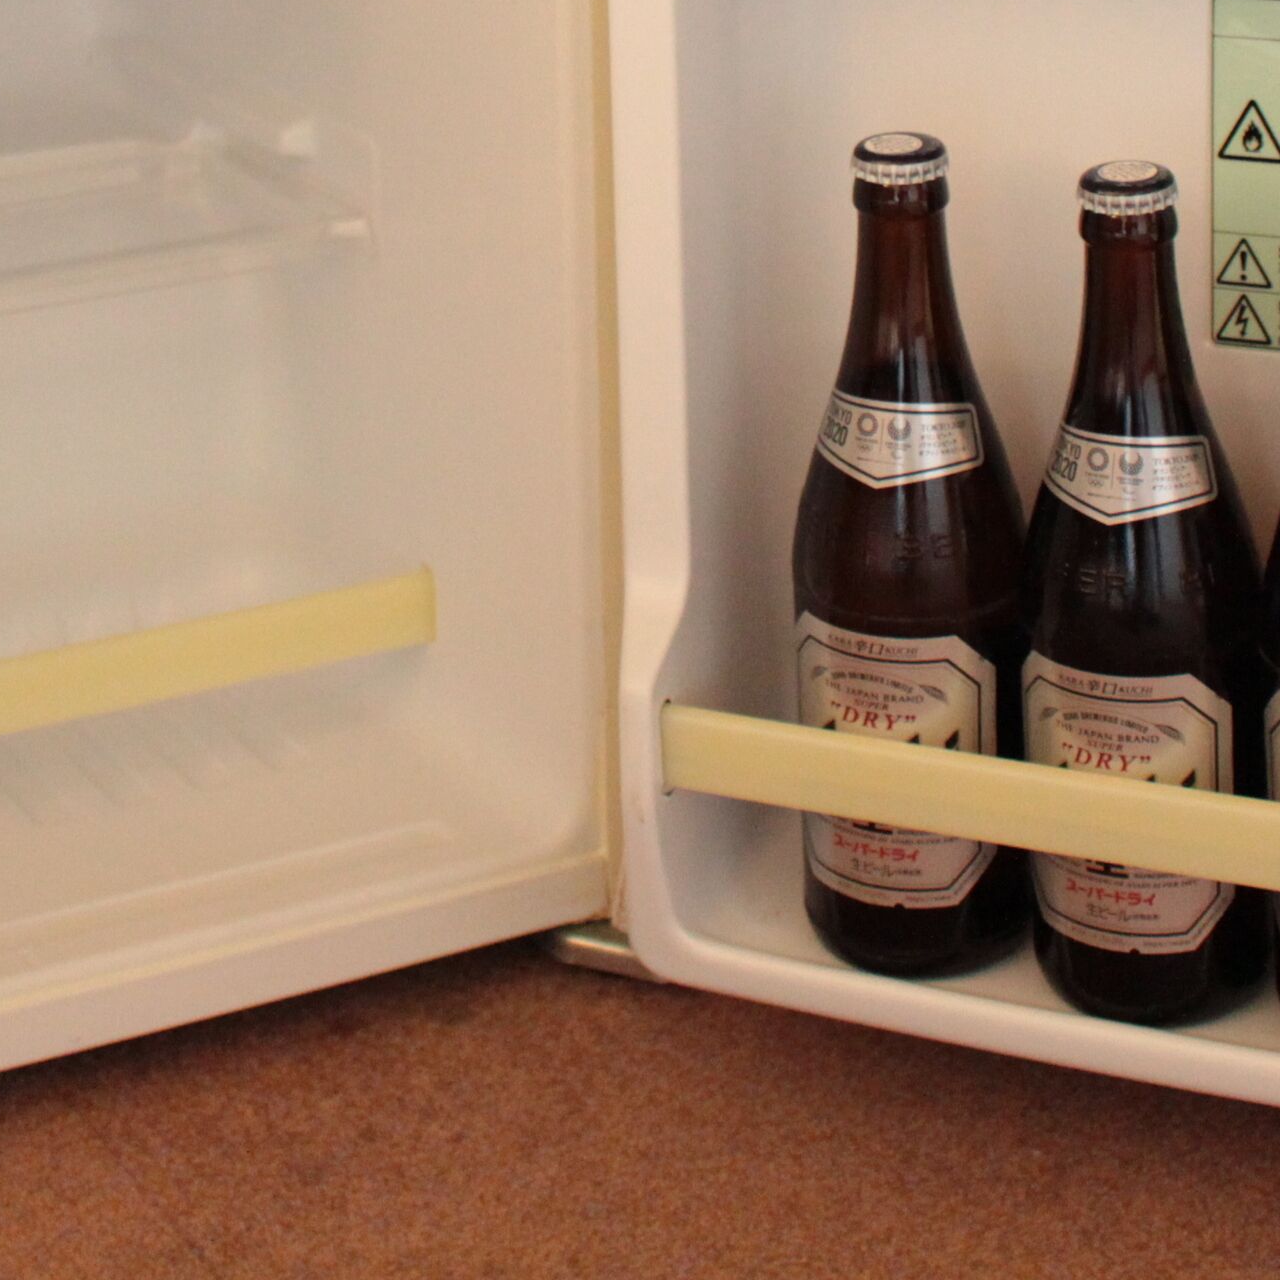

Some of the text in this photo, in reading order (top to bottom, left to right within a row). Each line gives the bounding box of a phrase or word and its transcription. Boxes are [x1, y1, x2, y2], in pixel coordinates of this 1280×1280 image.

[1117, 733, 1160, 744] BRAND
[1065, 877, 1157, 906] スーパードライ
